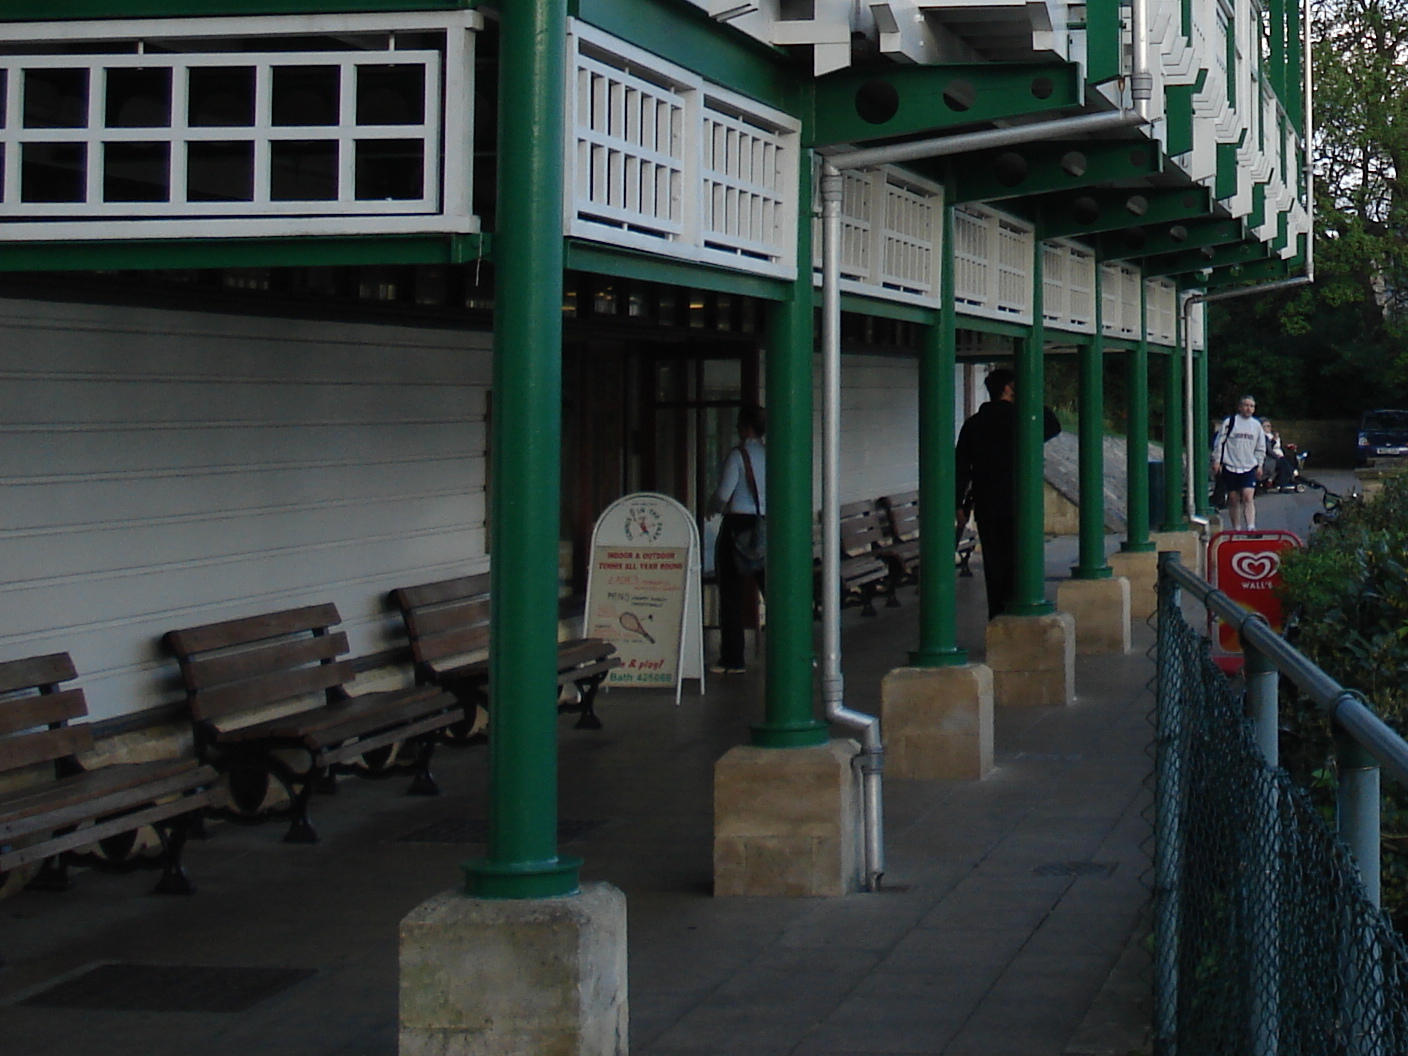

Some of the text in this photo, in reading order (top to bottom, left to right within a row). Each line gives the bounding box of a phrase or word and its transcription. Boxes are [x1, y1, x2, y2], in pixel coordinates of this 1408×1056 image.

[643, 552, 675, 560] OUTDOOR
[599, 562, 622, 570] TENNIS
[1241, 581, 1273, 590] WALL'S
[628, 658, 637, 668] &
[610, 672, 633, 682] Bath
